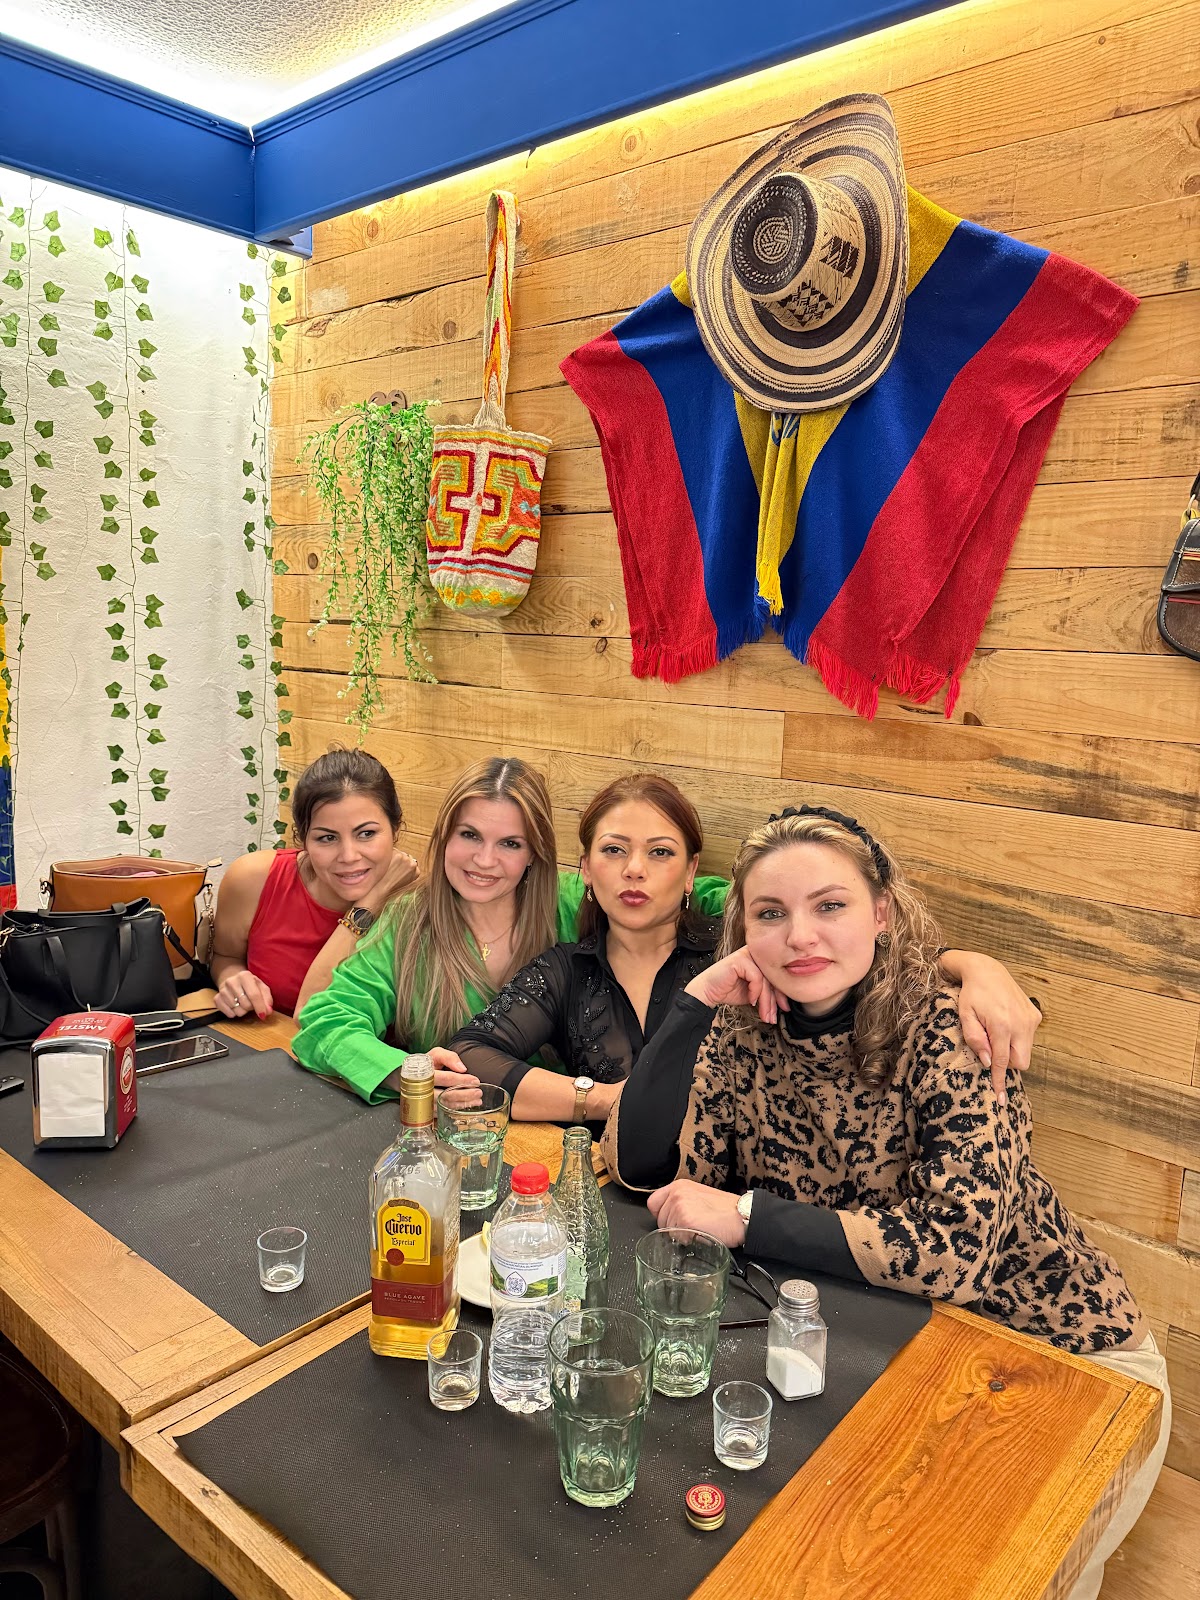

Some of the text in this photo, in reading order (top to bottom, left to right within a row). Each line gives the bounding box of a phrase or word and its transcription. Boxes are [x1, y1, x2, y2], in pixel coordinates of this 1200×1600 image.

[396, 1213, 412, 1223] Jose
[385, 1218, 422, 1236] Cuervo
[391, 1237, 416, 1246] Especial
[384, 1291, 402, 1299] BLUE
